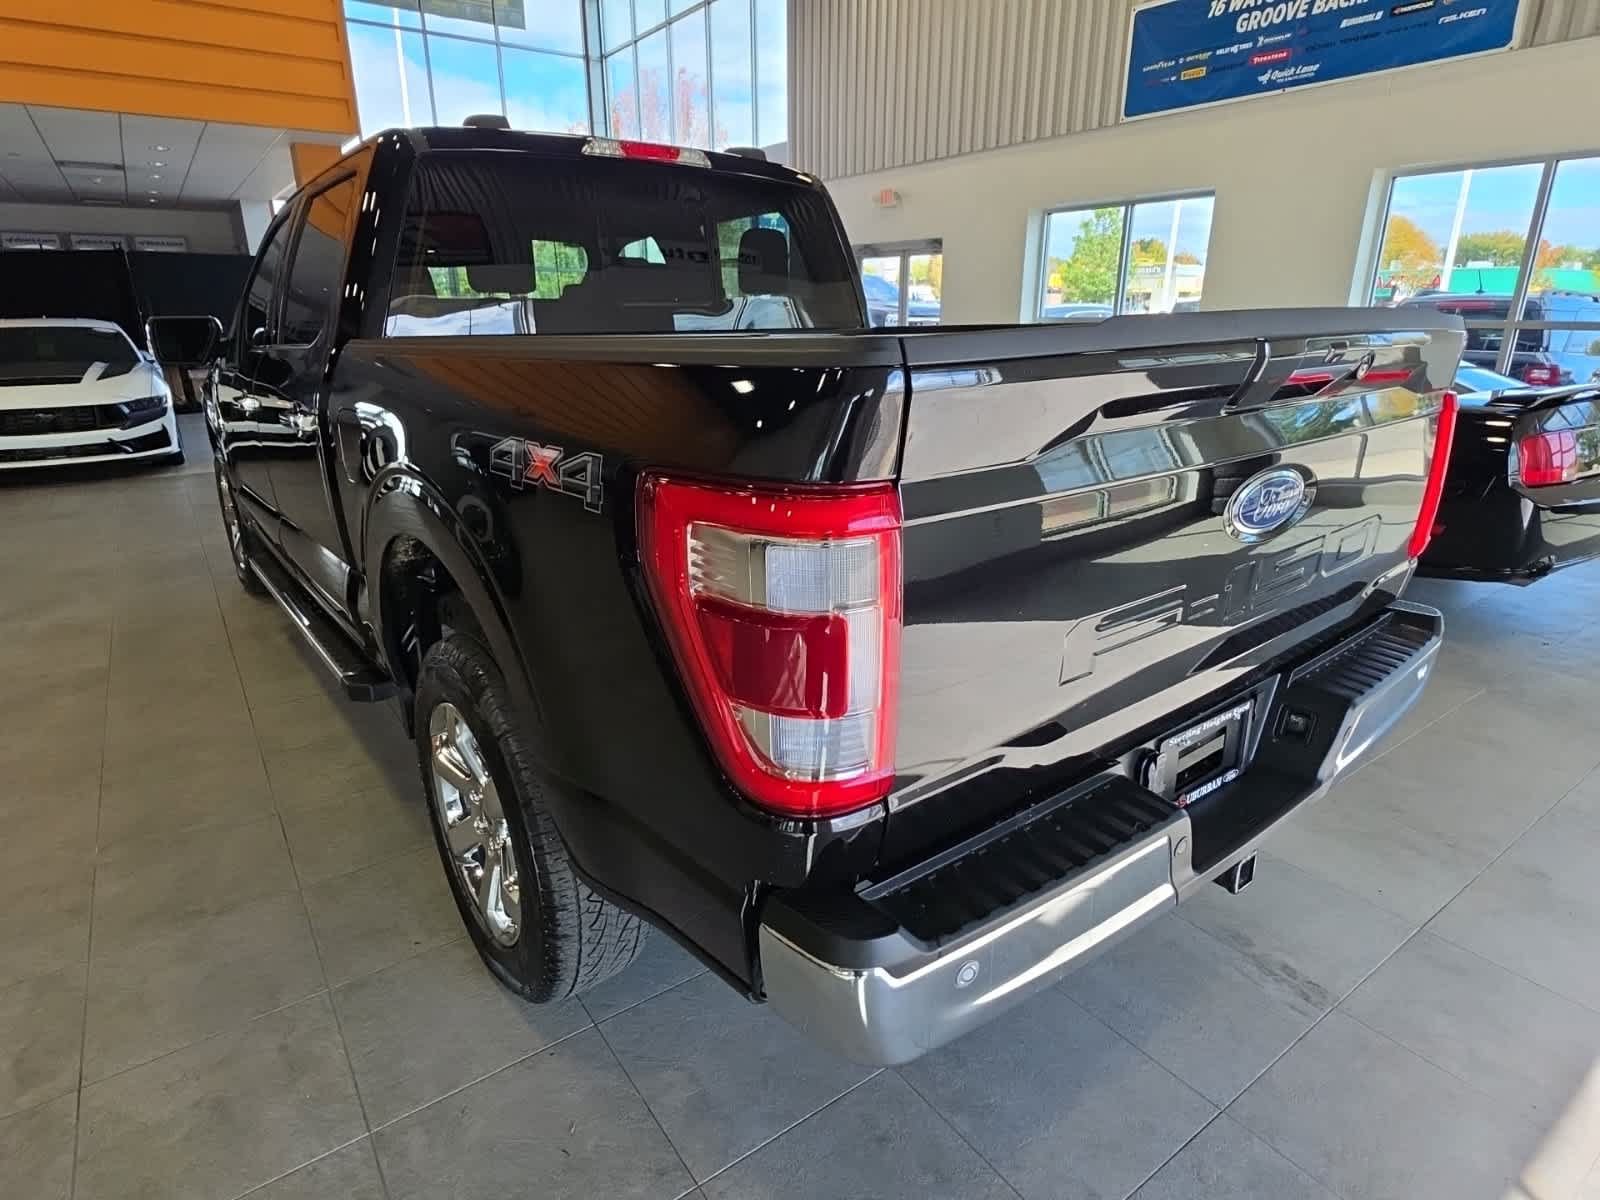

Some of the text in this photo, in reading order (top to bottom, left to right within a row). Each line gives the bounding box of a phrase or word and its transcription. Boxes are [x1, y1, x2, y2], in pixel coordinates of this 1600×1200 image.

[1208, 0, 1226, 18] 16
[1236, 0, 1309, 32] GROOVE
[1271, 67, 1295, 80] Quick
[1296, 64, 1320, 75] Lane
[1253, 485, 1293, 522] Ford
[1059, 513, 1382, 686] F-150
